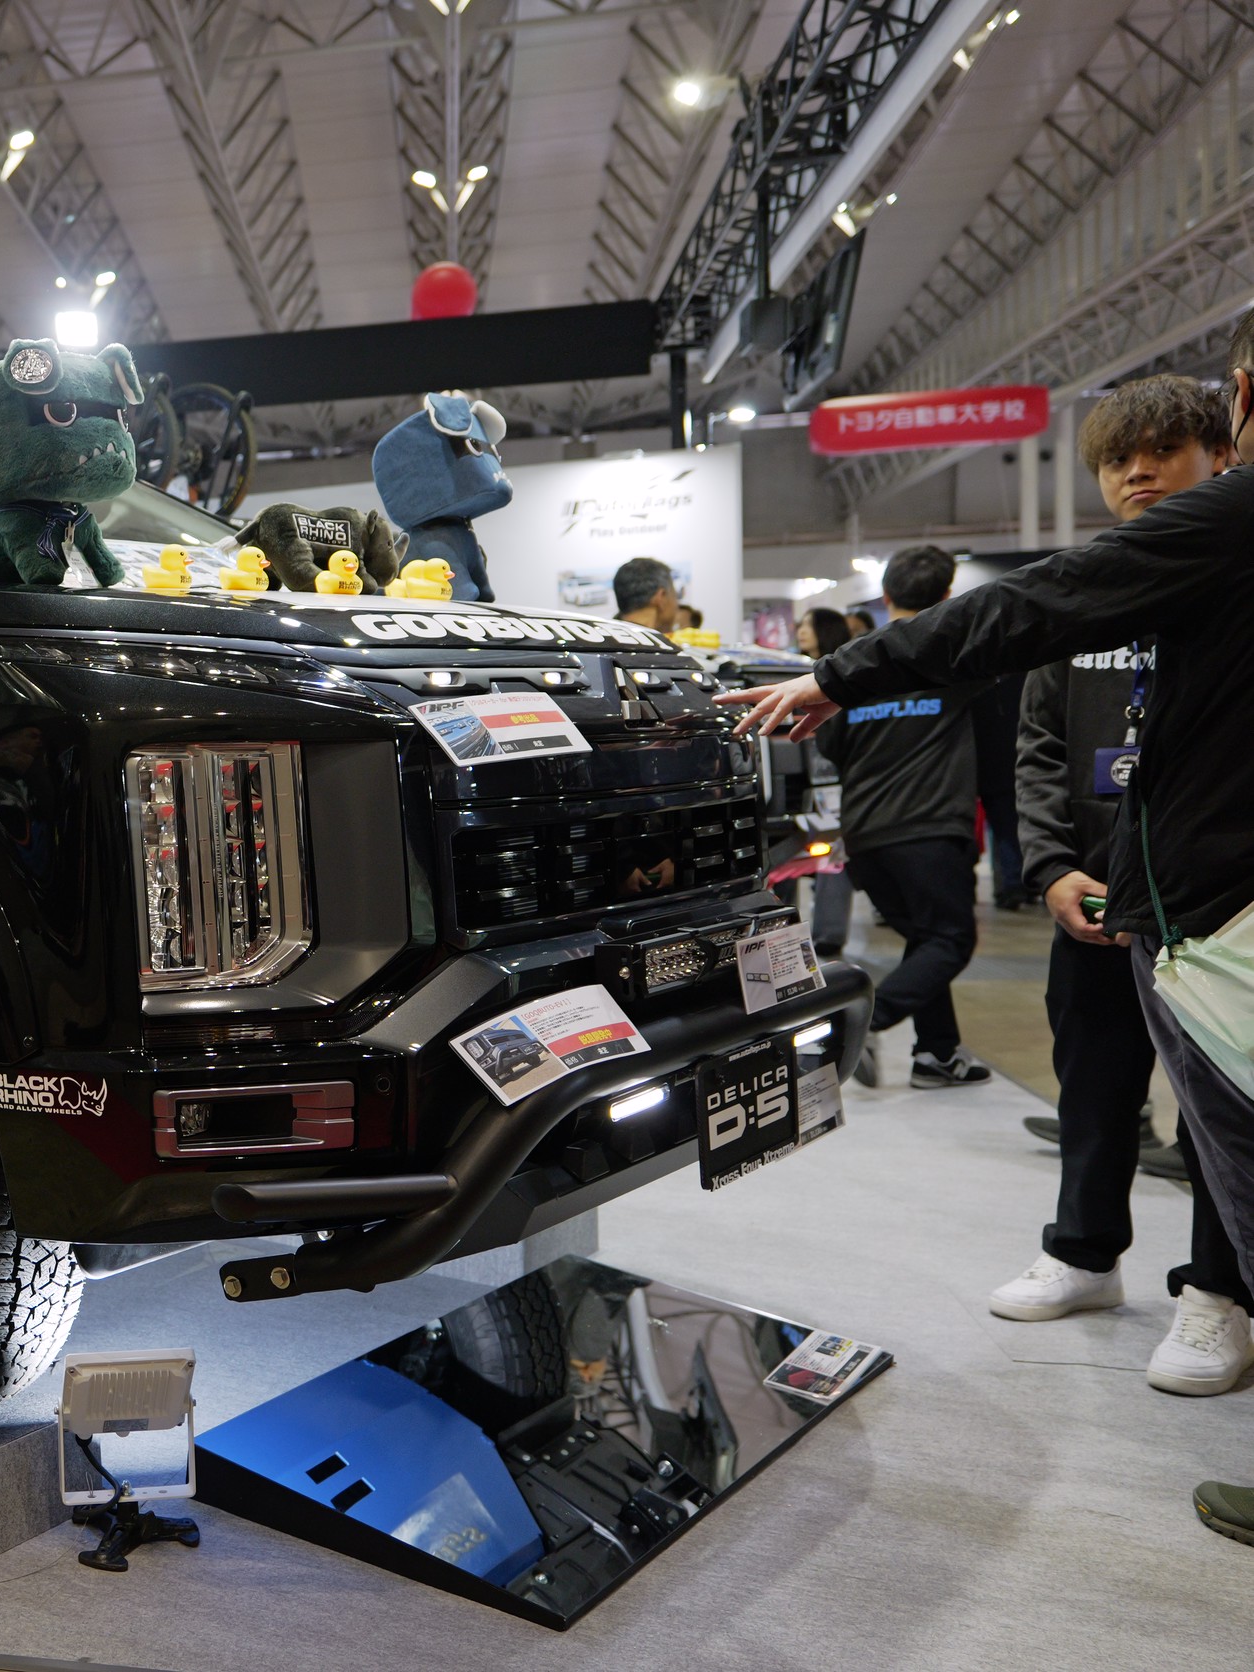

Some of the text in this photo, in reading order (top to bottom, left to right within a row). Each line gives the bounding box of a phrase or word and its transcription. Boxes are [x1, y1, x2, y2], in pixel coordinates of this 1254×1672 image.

[839, 399, 1026, 434] トヨタ自動車大学校
[298, 516, 345, 532] BLACK
[300, 525, 347, 541] RHINO
[707, 1064, 789, 1111] DELICA
[16, 1104, 43, 1114] ALLOY
[44, 1106, 83, 1116] WHEELS
[708, 1083, 790, 1151] D:5
[711, 1142, 796, 1192] Xross Four Xtreme
